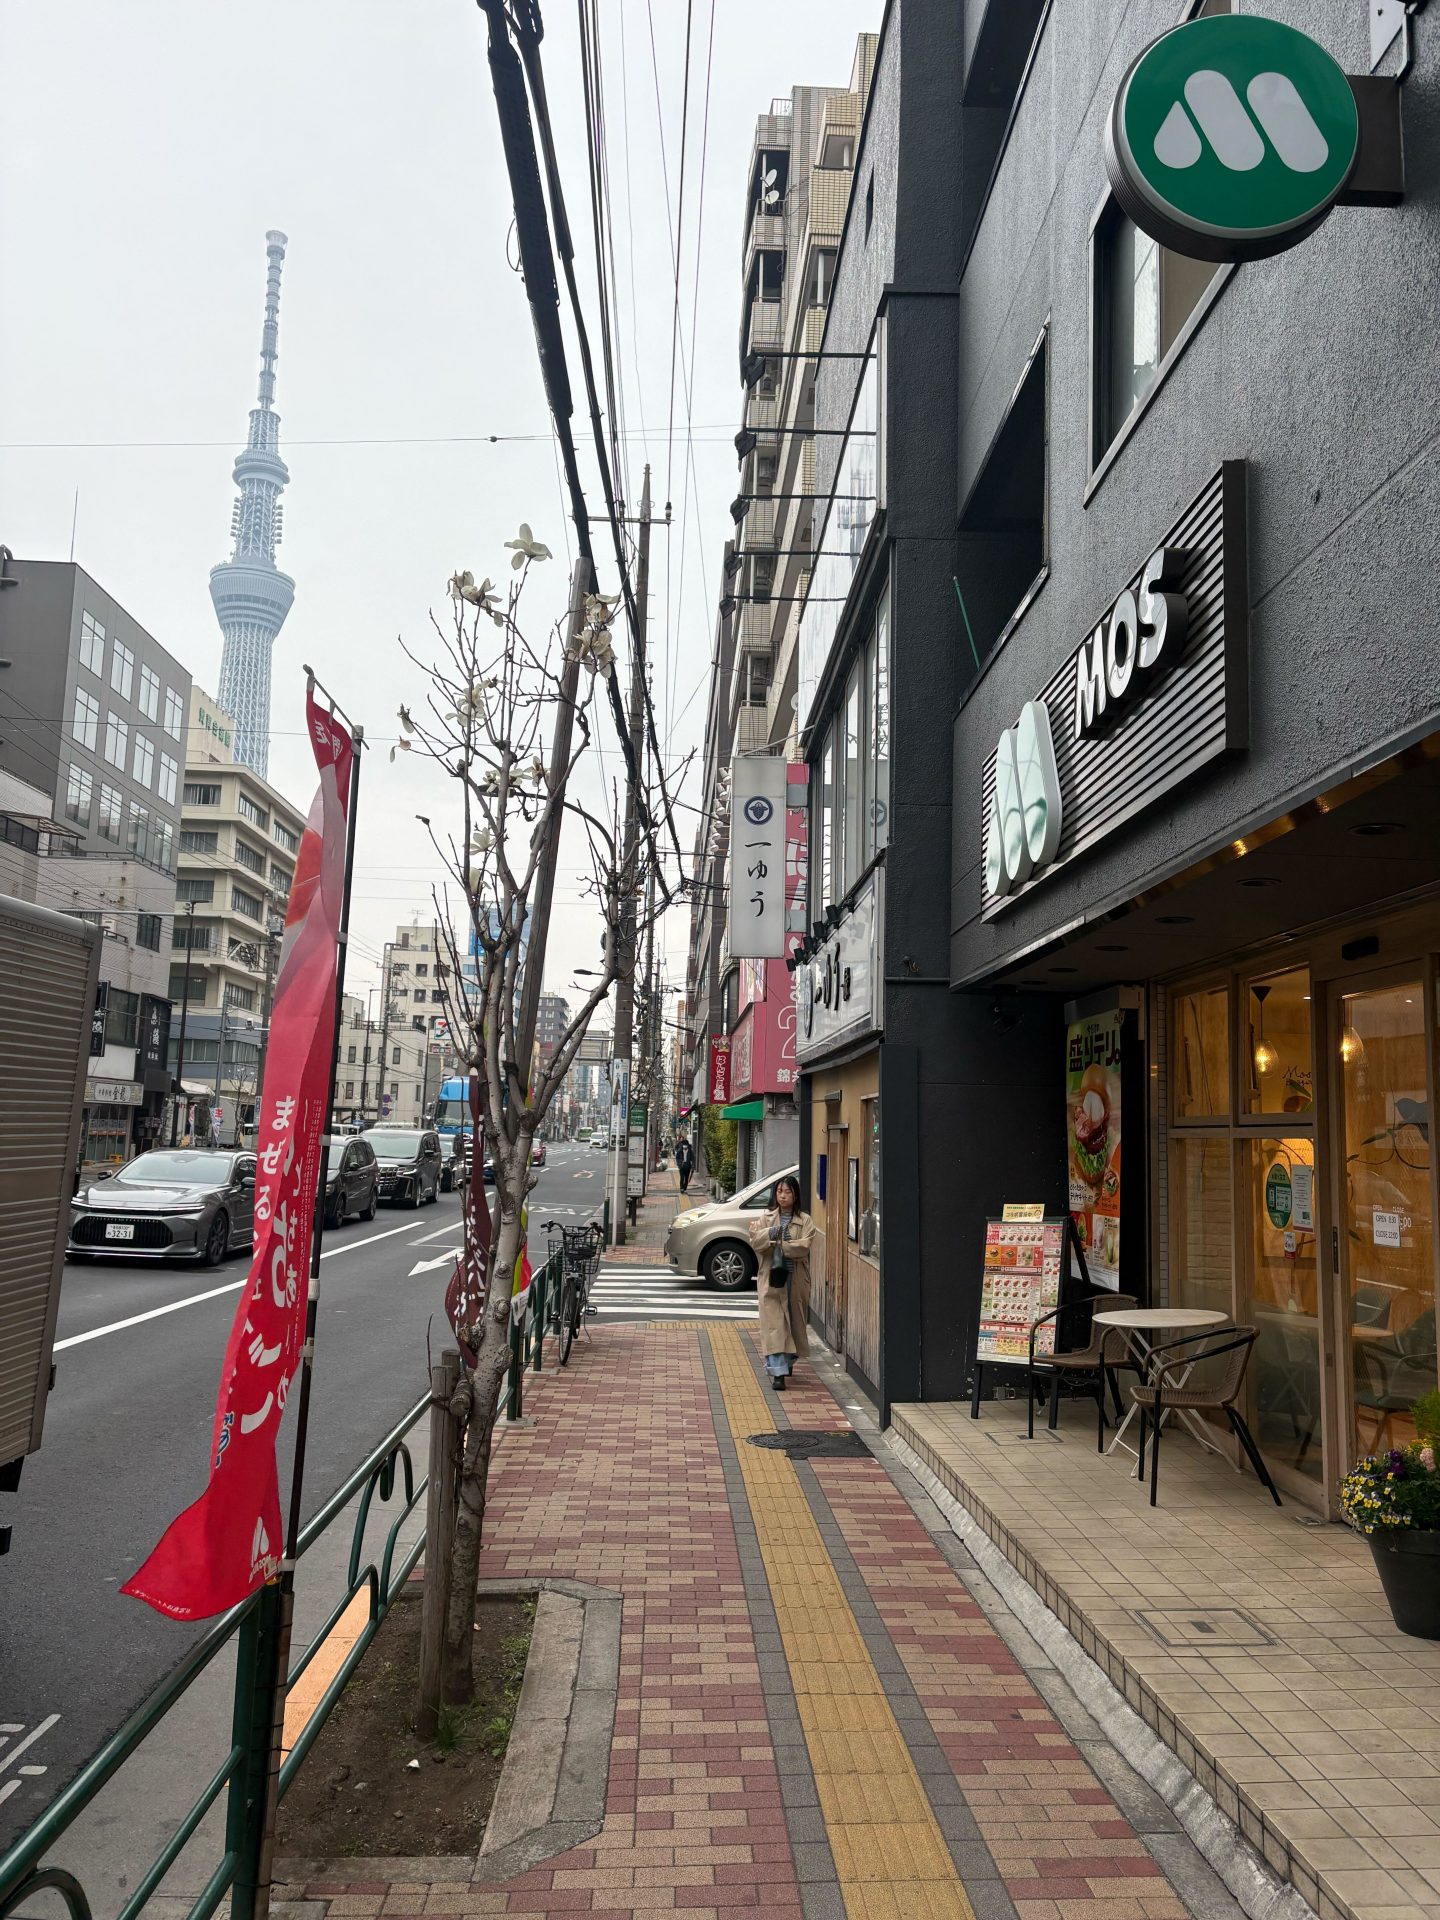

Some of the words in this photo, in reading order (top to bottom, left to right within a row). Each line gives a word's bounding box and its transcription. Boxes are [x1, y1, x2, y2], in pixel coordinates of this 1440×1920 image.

[1074, 546, 1189, 740] MOS
[744, 839, 773, 918] 一ゆう
[1375, 1215, 1387, 1223] OPEN
[1375, 1230, 1388, 1239] CLOSE
